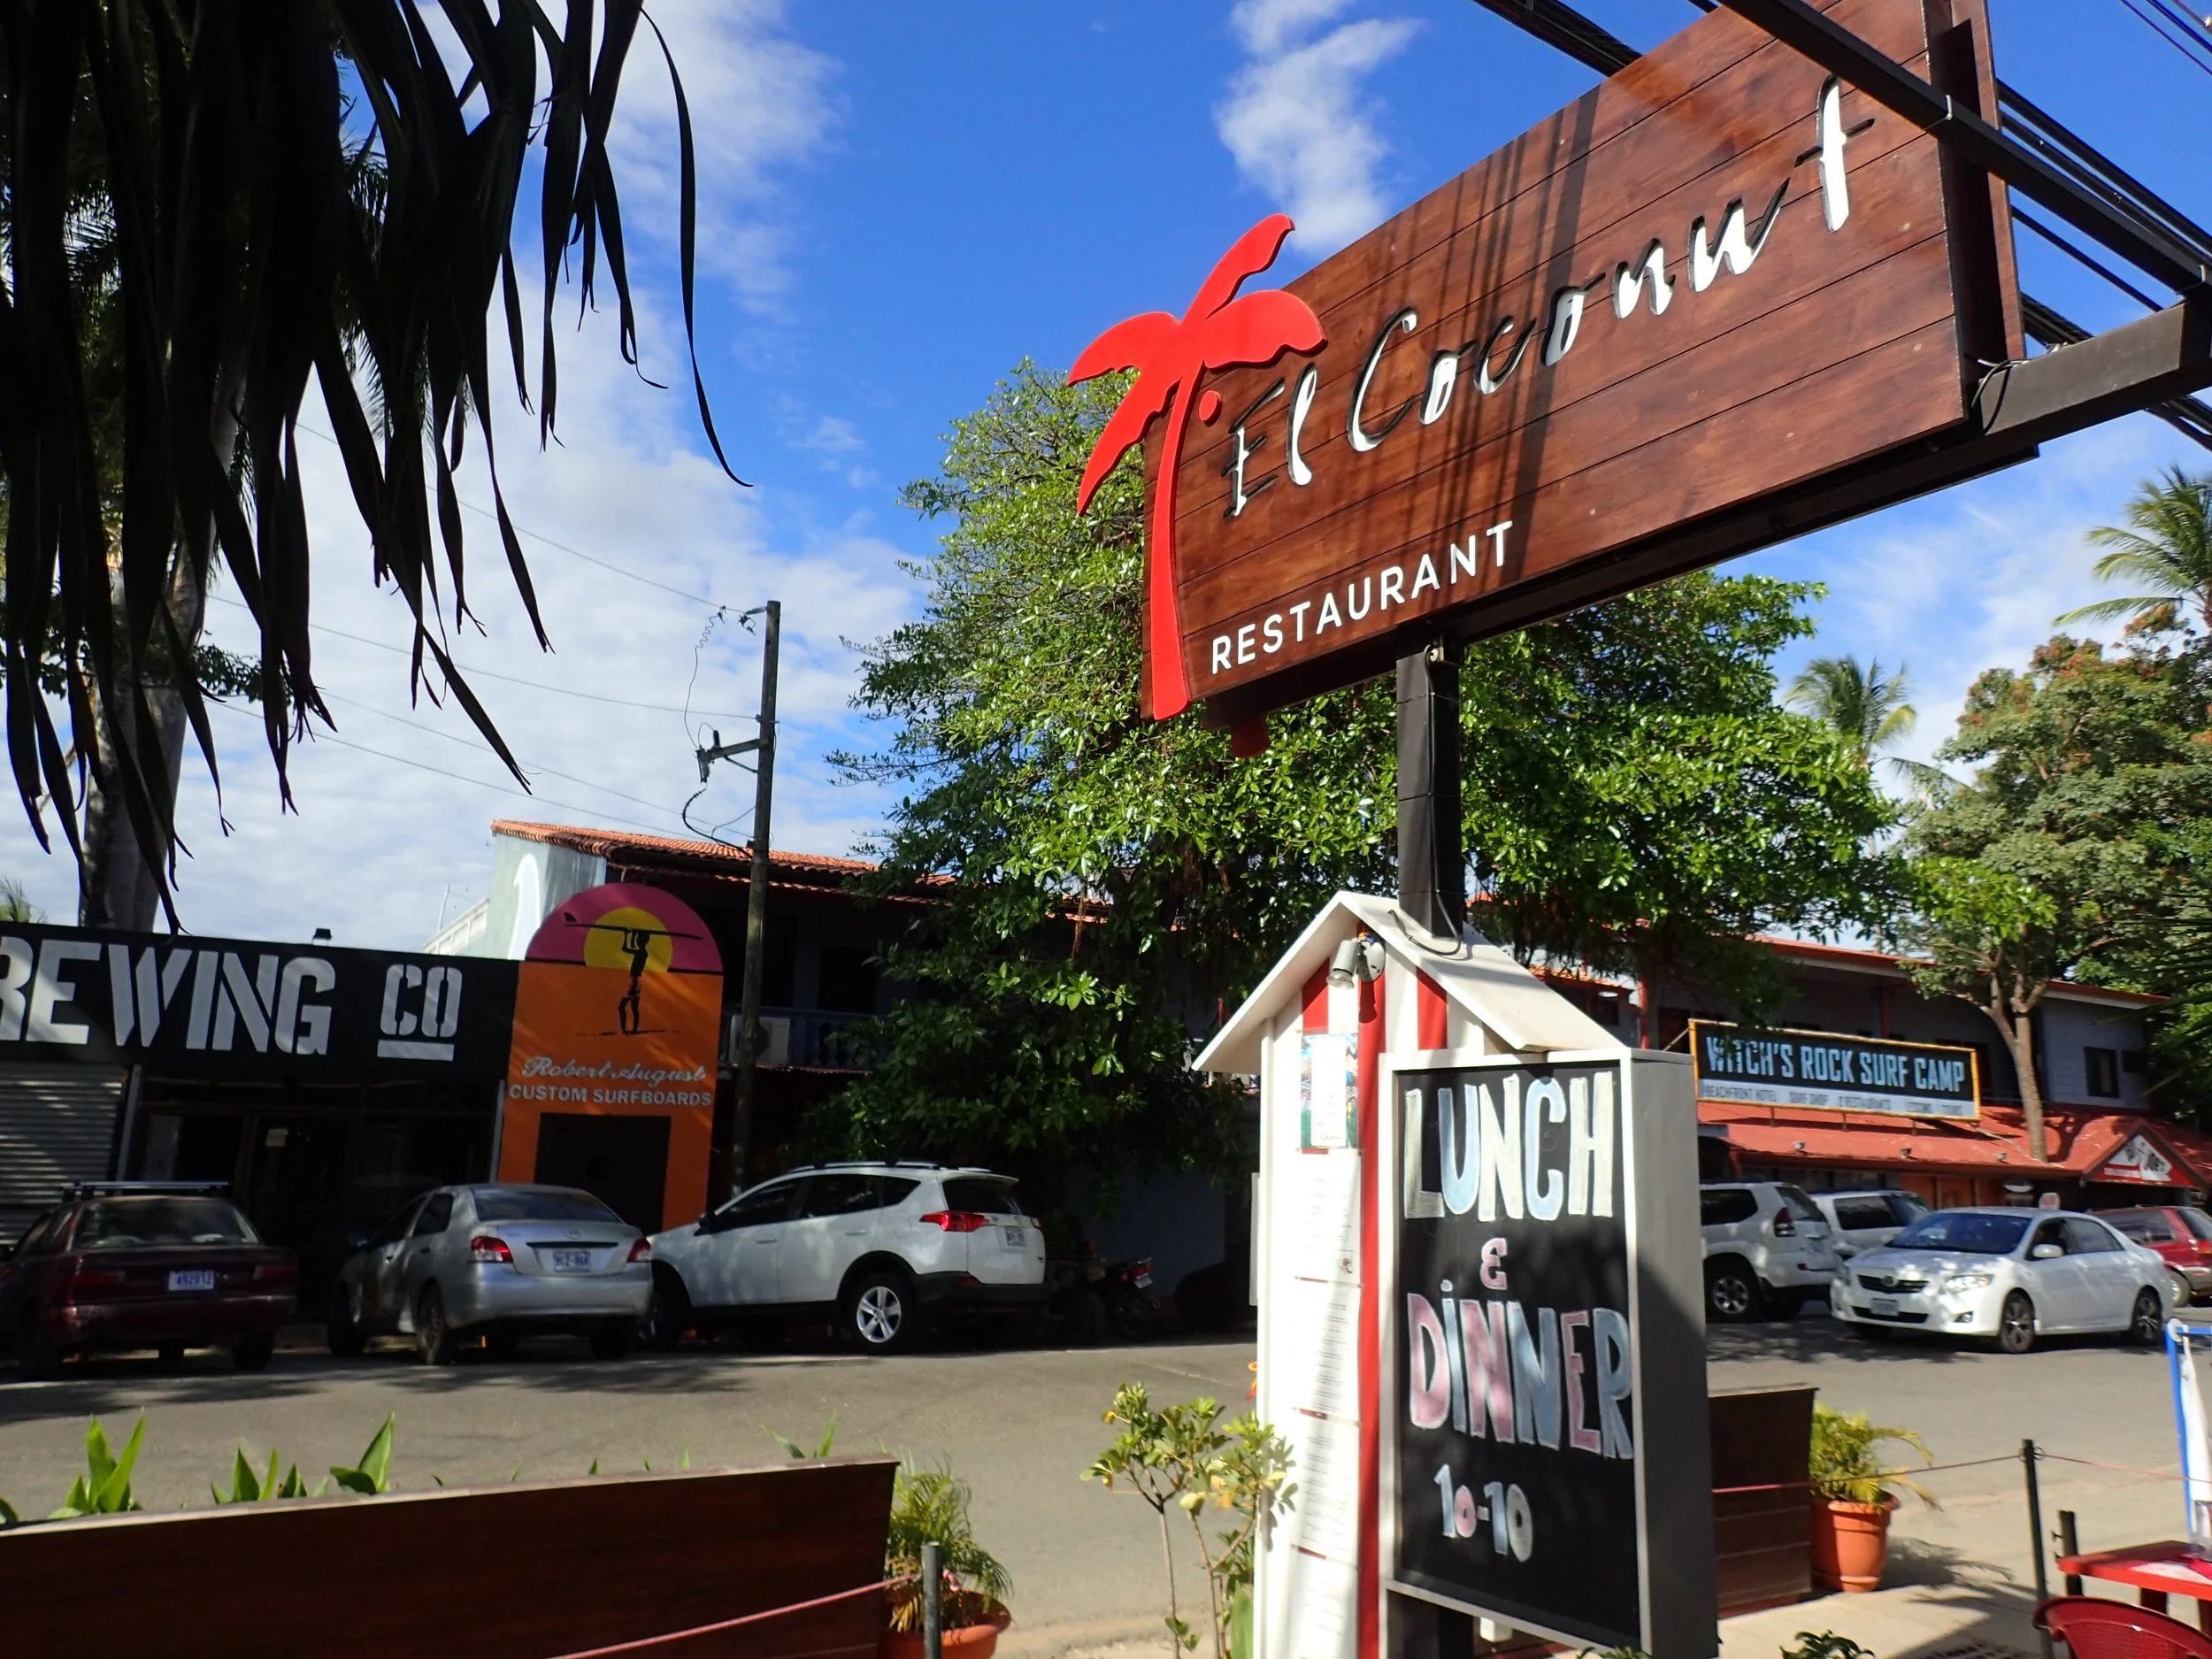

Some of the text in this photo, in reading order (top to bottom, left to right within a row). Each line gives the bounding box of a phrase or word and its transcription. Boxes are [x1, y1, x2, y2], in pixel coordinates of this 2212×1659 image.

[1221, 74, 1876, 519] El Coconut
[1211, 520, 1513, 674] RESTAURANT
[380, 964, 463, 1038] CO
[509, 1084, 711, 1106] CUSTOM SURFBOARDS
[520, 1056, 706, 1087] Robert August
[1705, 1036, 1965, 1093] WITCH'S ROCK SURF CAMP
[1403, 1071, 1614, 1222] LUNCH
[1433, 1464, 1533, 1563] 10-10
